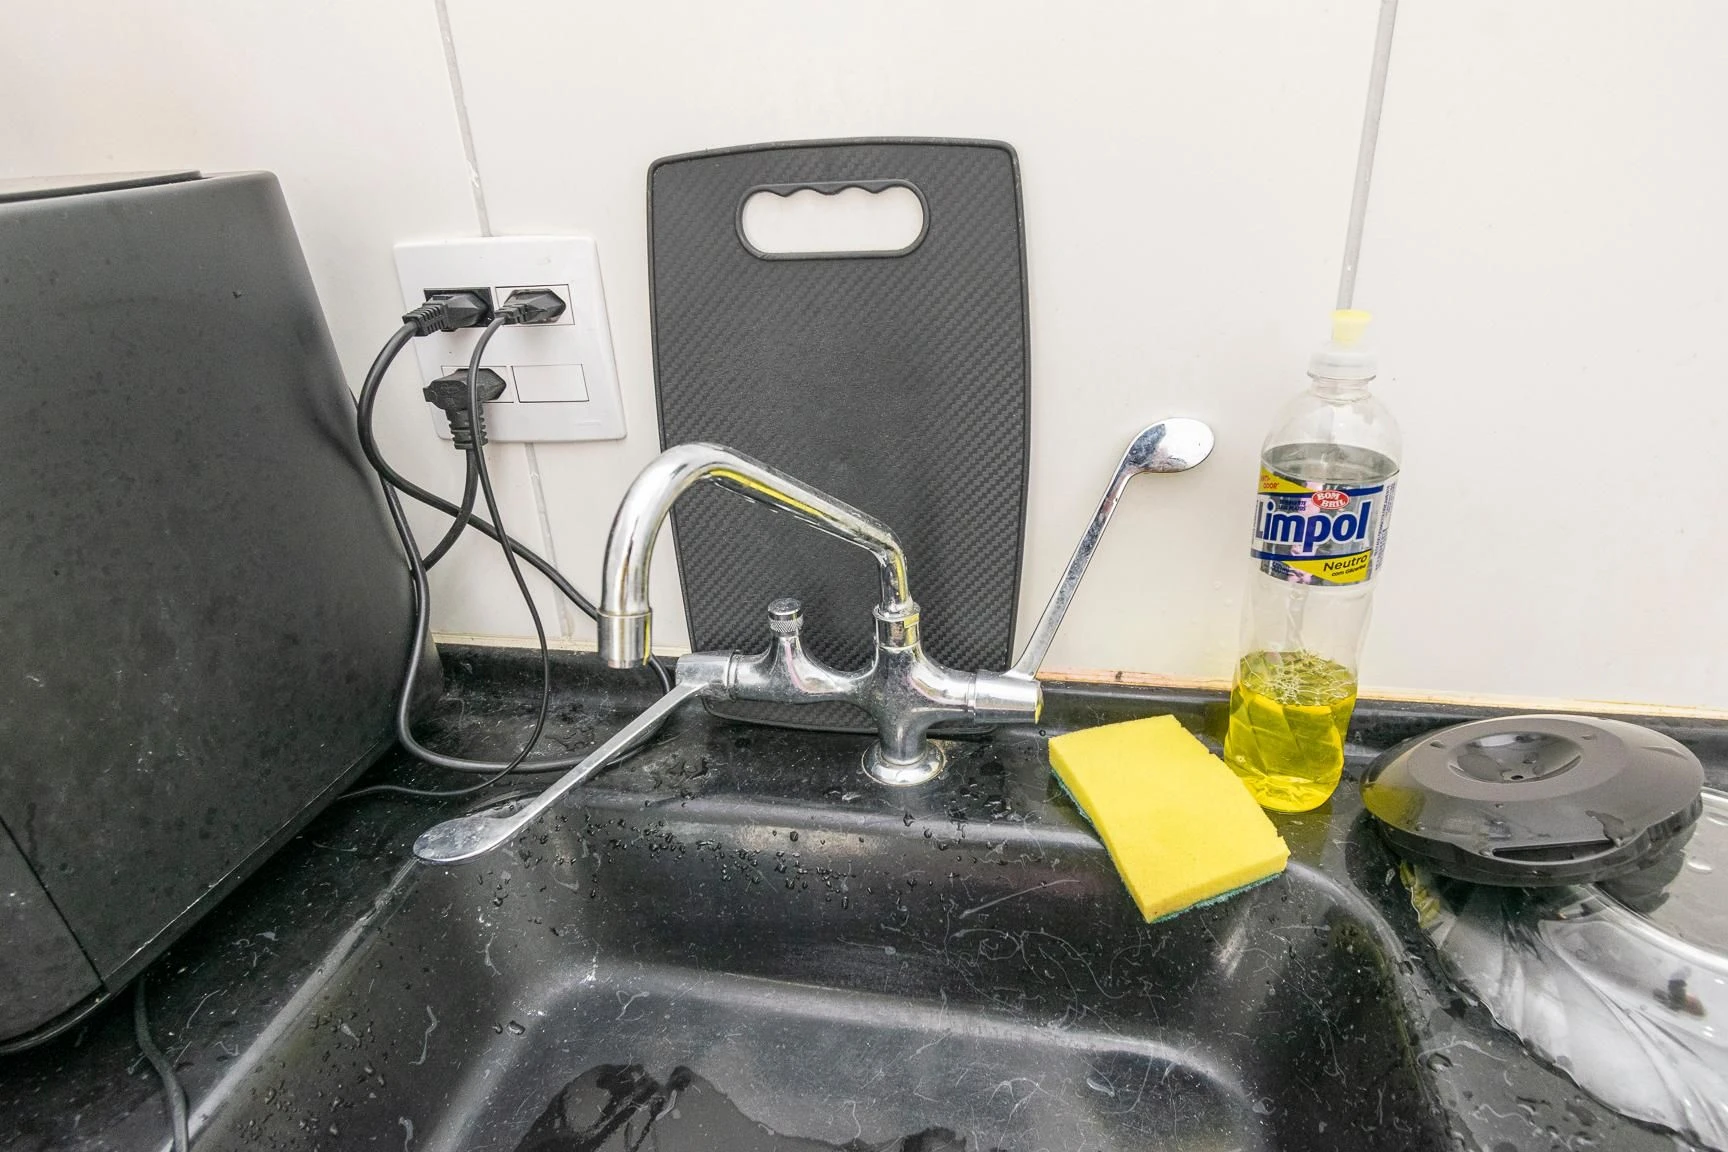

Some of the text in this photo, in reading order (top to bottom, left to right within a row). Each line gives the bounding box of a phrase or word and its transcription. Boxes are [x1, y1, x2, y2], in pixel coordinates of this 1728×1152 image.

[1317, 492, 1340, 501] BOM
[1321, 499, 1346, 508] BRIL
[1256, 501, 1371, 553] Limpol
[1323, 555, 1368, 572] Neutro
